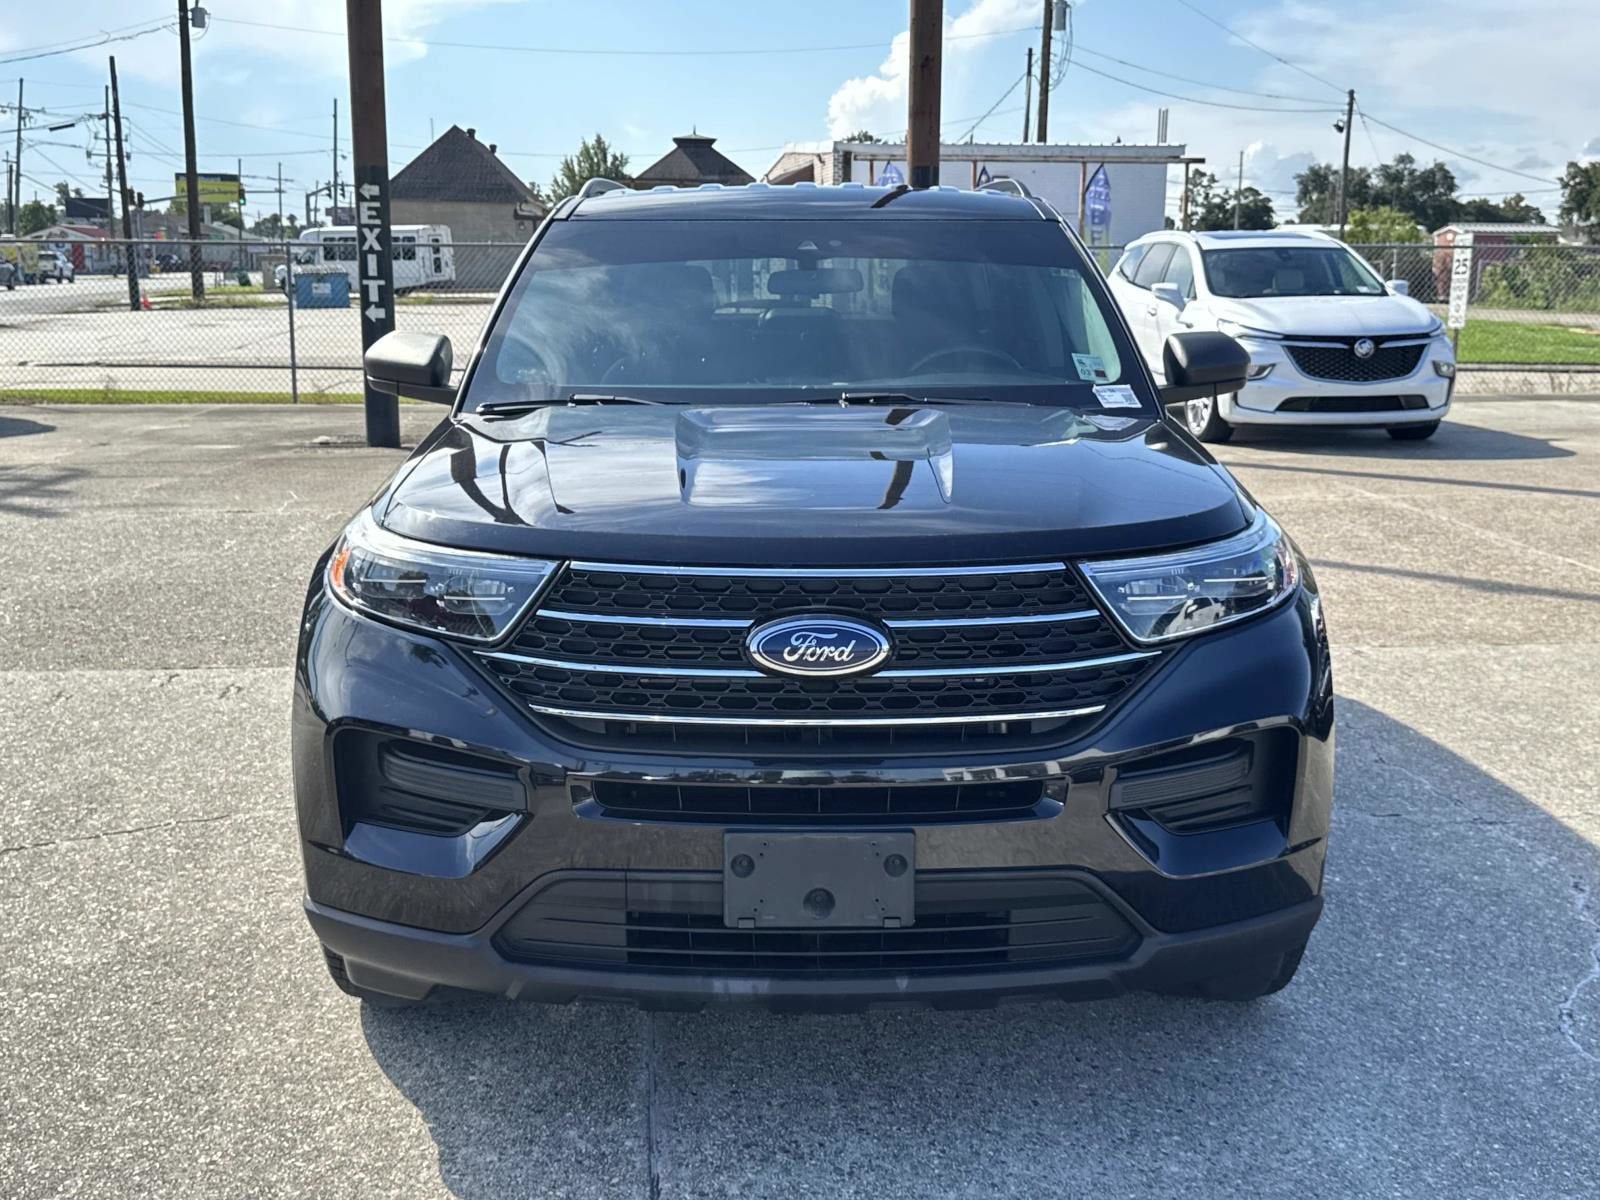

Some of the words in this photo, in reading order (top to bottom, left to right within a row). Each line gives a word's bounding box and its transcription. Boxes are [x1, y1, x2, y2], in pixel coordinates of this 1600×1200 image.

[359, 201, 386, 303] EXIT
[1453, 257, 1470, 276] 25
[783, 631, 857, 662] Ford
